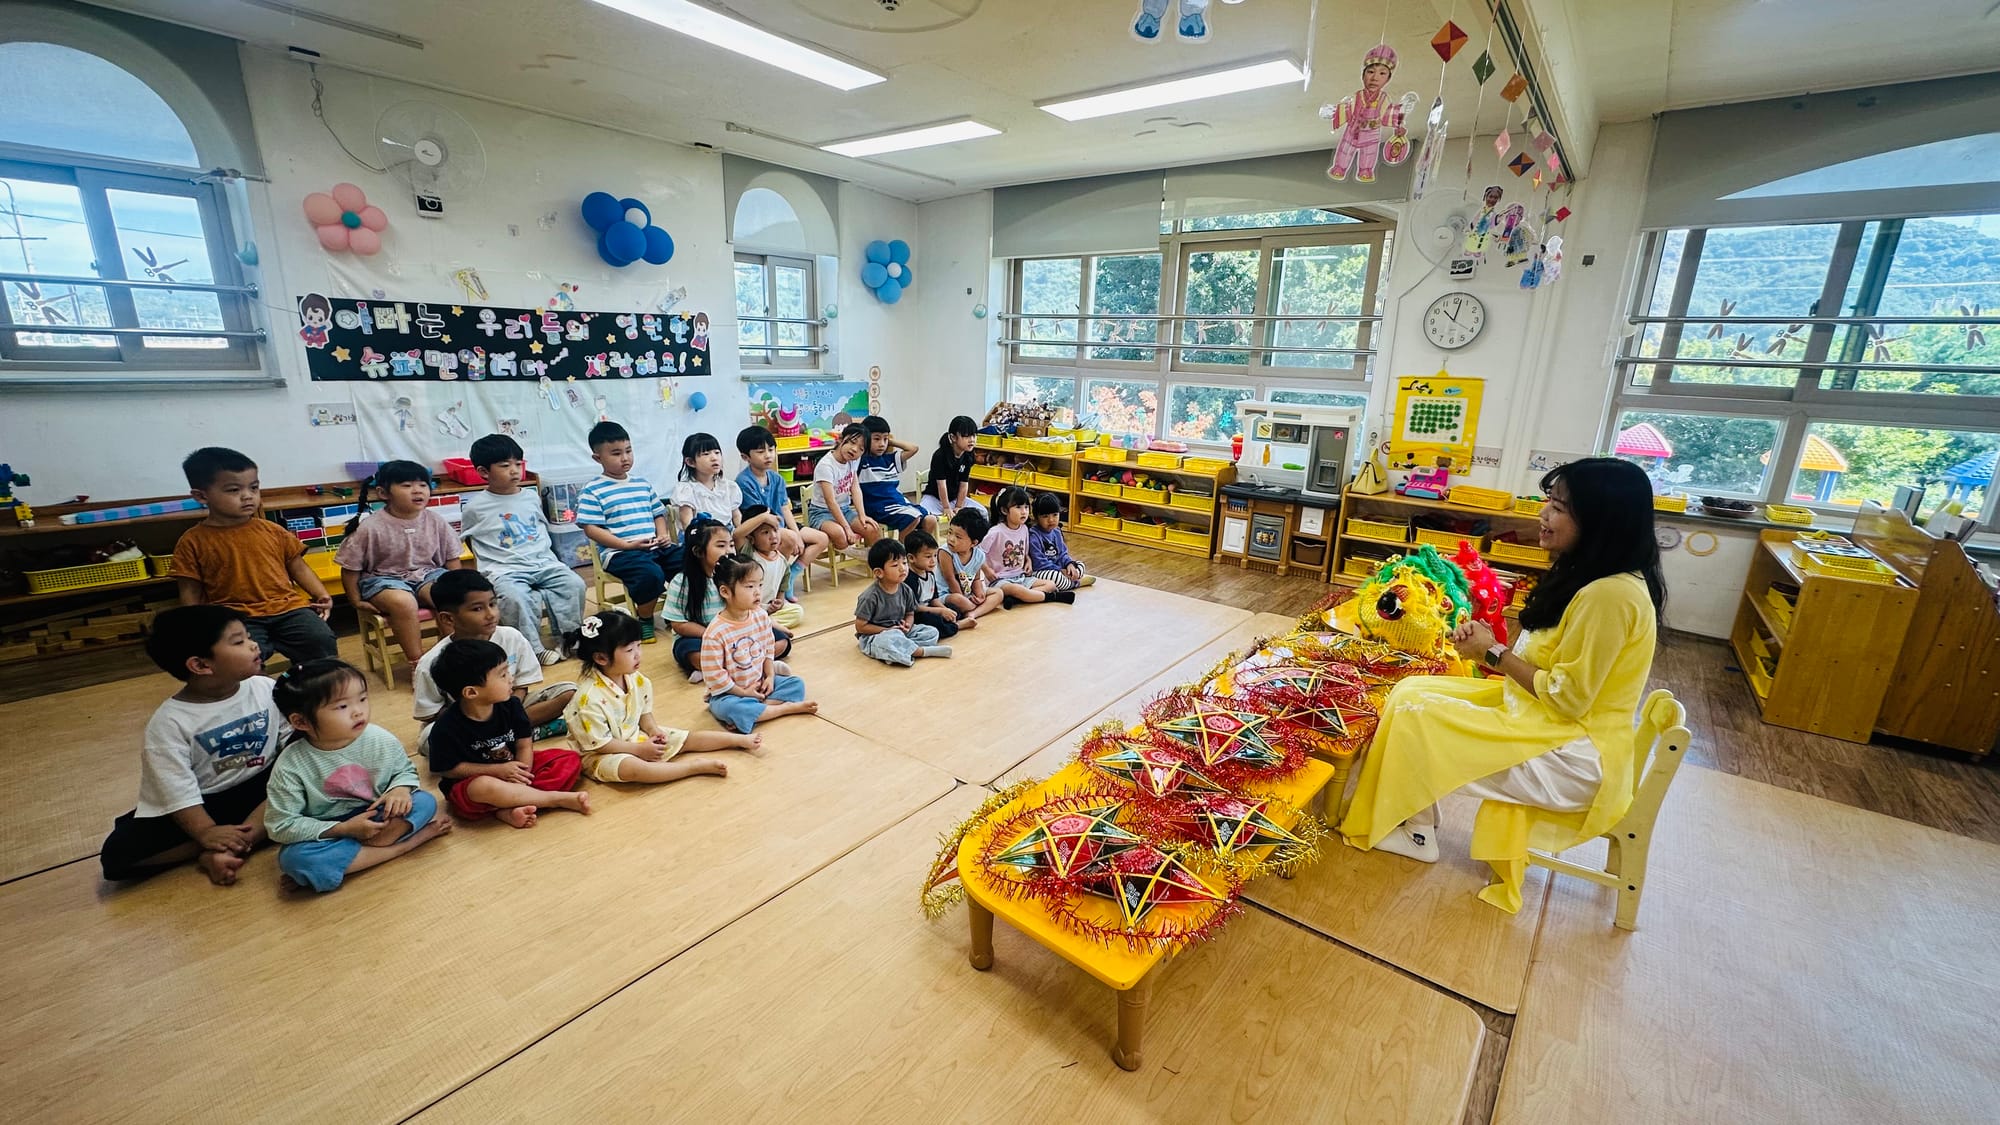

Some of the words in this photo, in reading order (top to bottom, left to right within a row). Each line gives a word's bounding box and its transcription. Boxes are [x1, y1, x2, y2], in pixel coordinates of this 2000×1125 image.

[1471, 306, 1477, 314] 2
[335, 302, 446, 338] 아빠는
[476, 309, 590, 345] 우리들의
[616, 313, 690, 344] 영원한
[1474, 316, 1479, 324] 3
[1432, 327, 1437, 335] 8
[1460, 334, 1465, 342] 5
[585, 350, 688, 378] 사랑해요!
